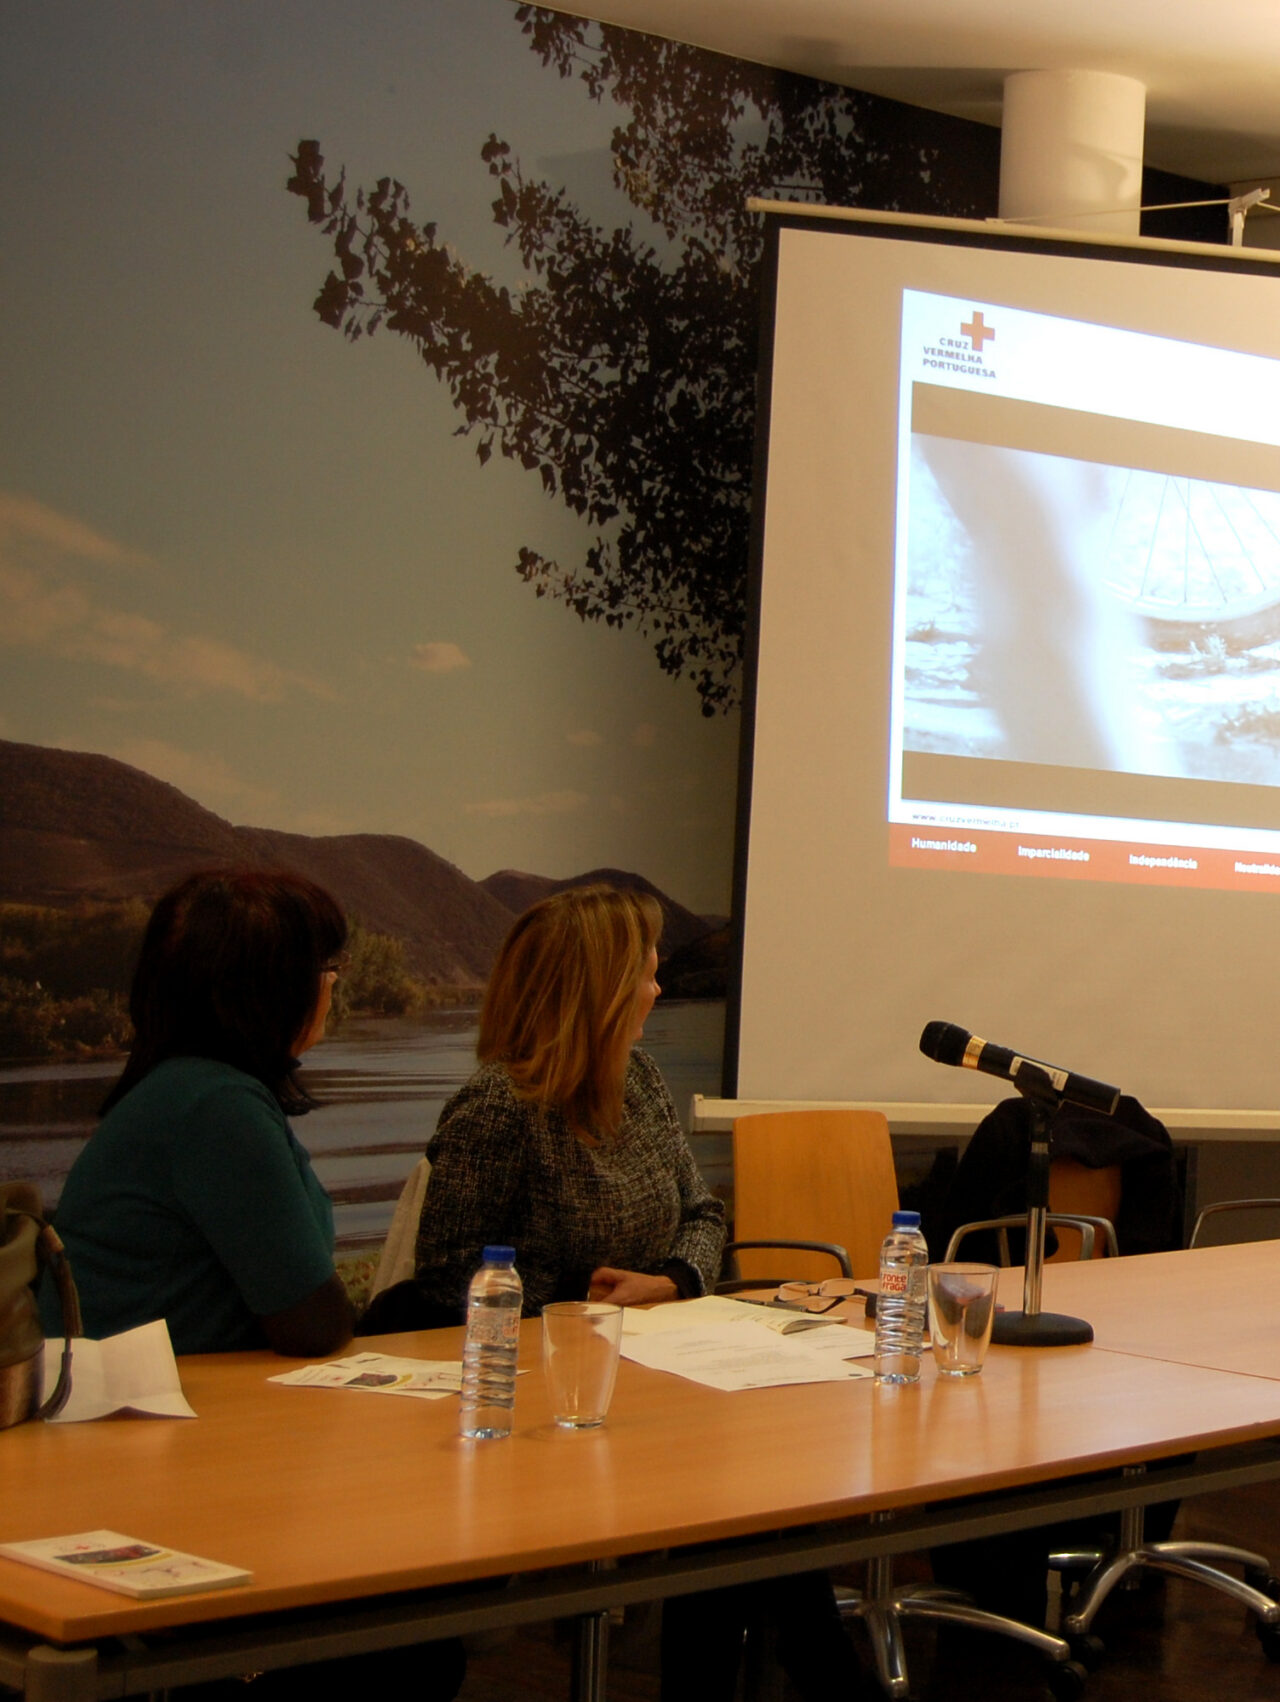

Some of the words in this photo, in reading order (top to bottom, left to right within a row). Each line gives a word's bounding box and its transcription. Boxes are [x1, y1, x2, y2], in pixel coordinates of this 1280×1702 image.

[939, 337, 969, 350] CRUZ
[923, 346, 983, 364] VERMELHA
[922, 358, 997, 378] PORTUGUESA
[911, 837, 977, 853] Humanidade
[1018, 845, 1090, 862] Imparcialidade
